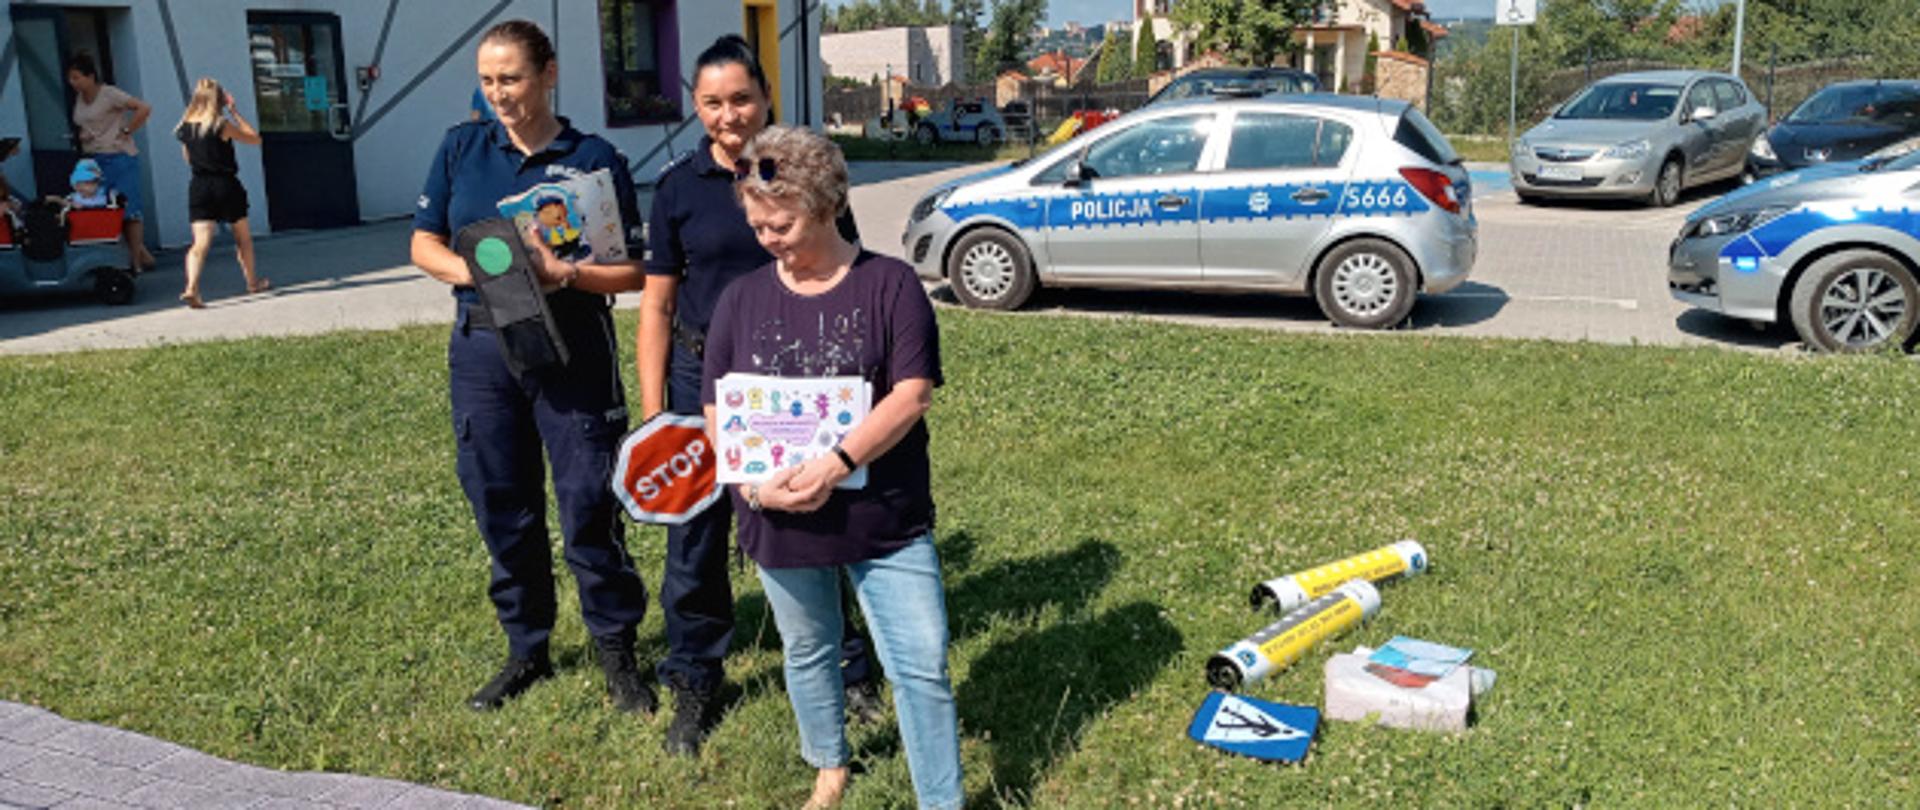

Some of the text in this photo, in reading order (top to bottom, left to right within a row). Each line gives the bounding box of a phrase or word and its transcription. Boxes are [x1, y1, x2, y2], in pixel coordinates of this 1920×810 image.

[1346, 186, 1407, 208] S666
[1071, 200, 1152, 220] POLICJA
[636, 439, 705, 500] STOP
